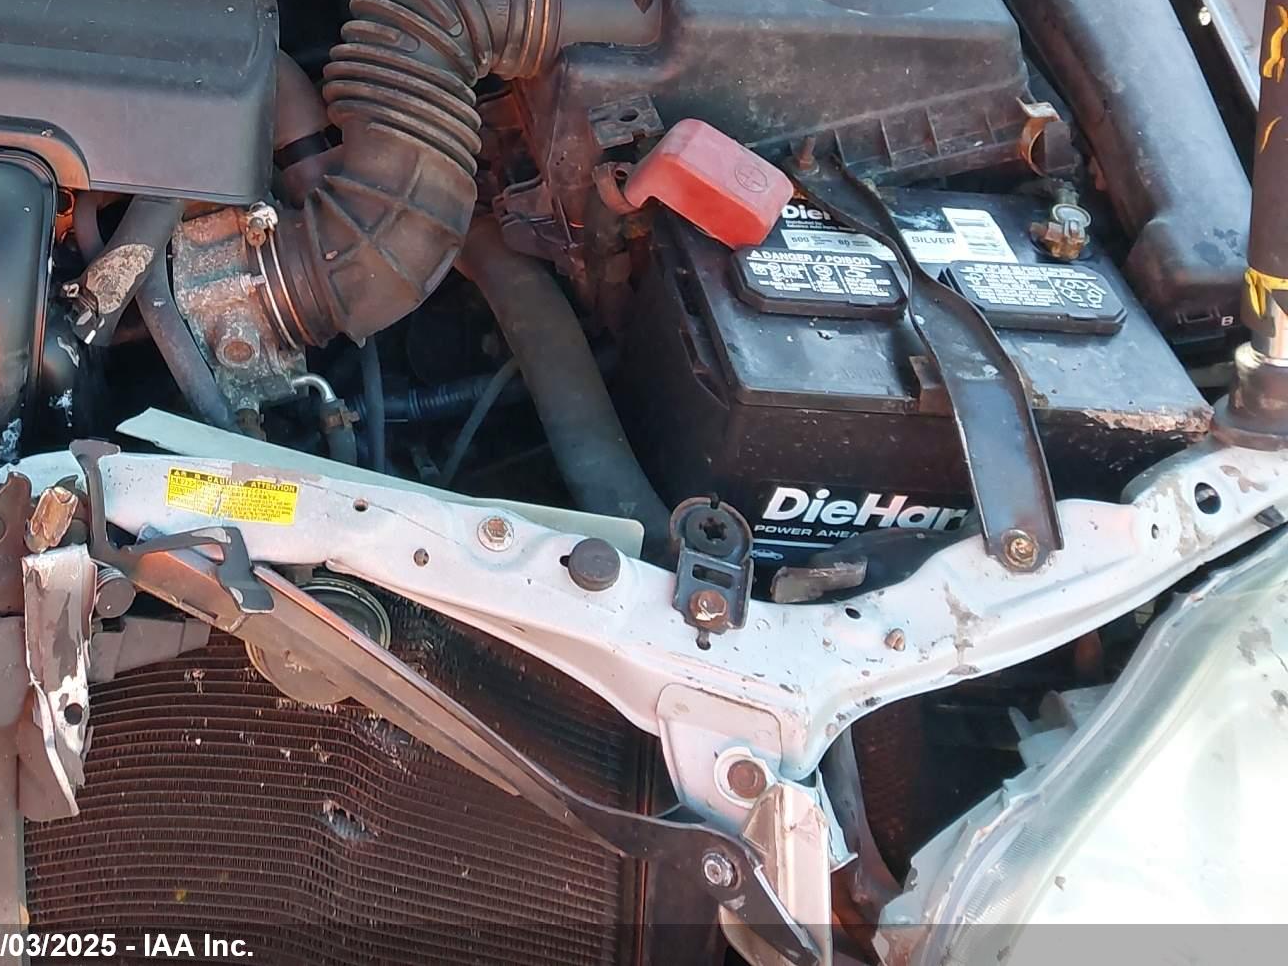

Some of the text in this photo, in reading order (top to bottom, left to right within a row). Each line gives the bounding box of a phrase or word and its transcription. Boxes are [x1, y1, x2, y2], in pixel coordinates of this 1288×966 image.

[911, 235, 957, 245] SILVER
[760, 251, 813, 263] DANGER
[824, 255, 872, 266] POISON
[250, 480, 296, 493] ATTENTION
[754, 524, 813, 537] POWER
